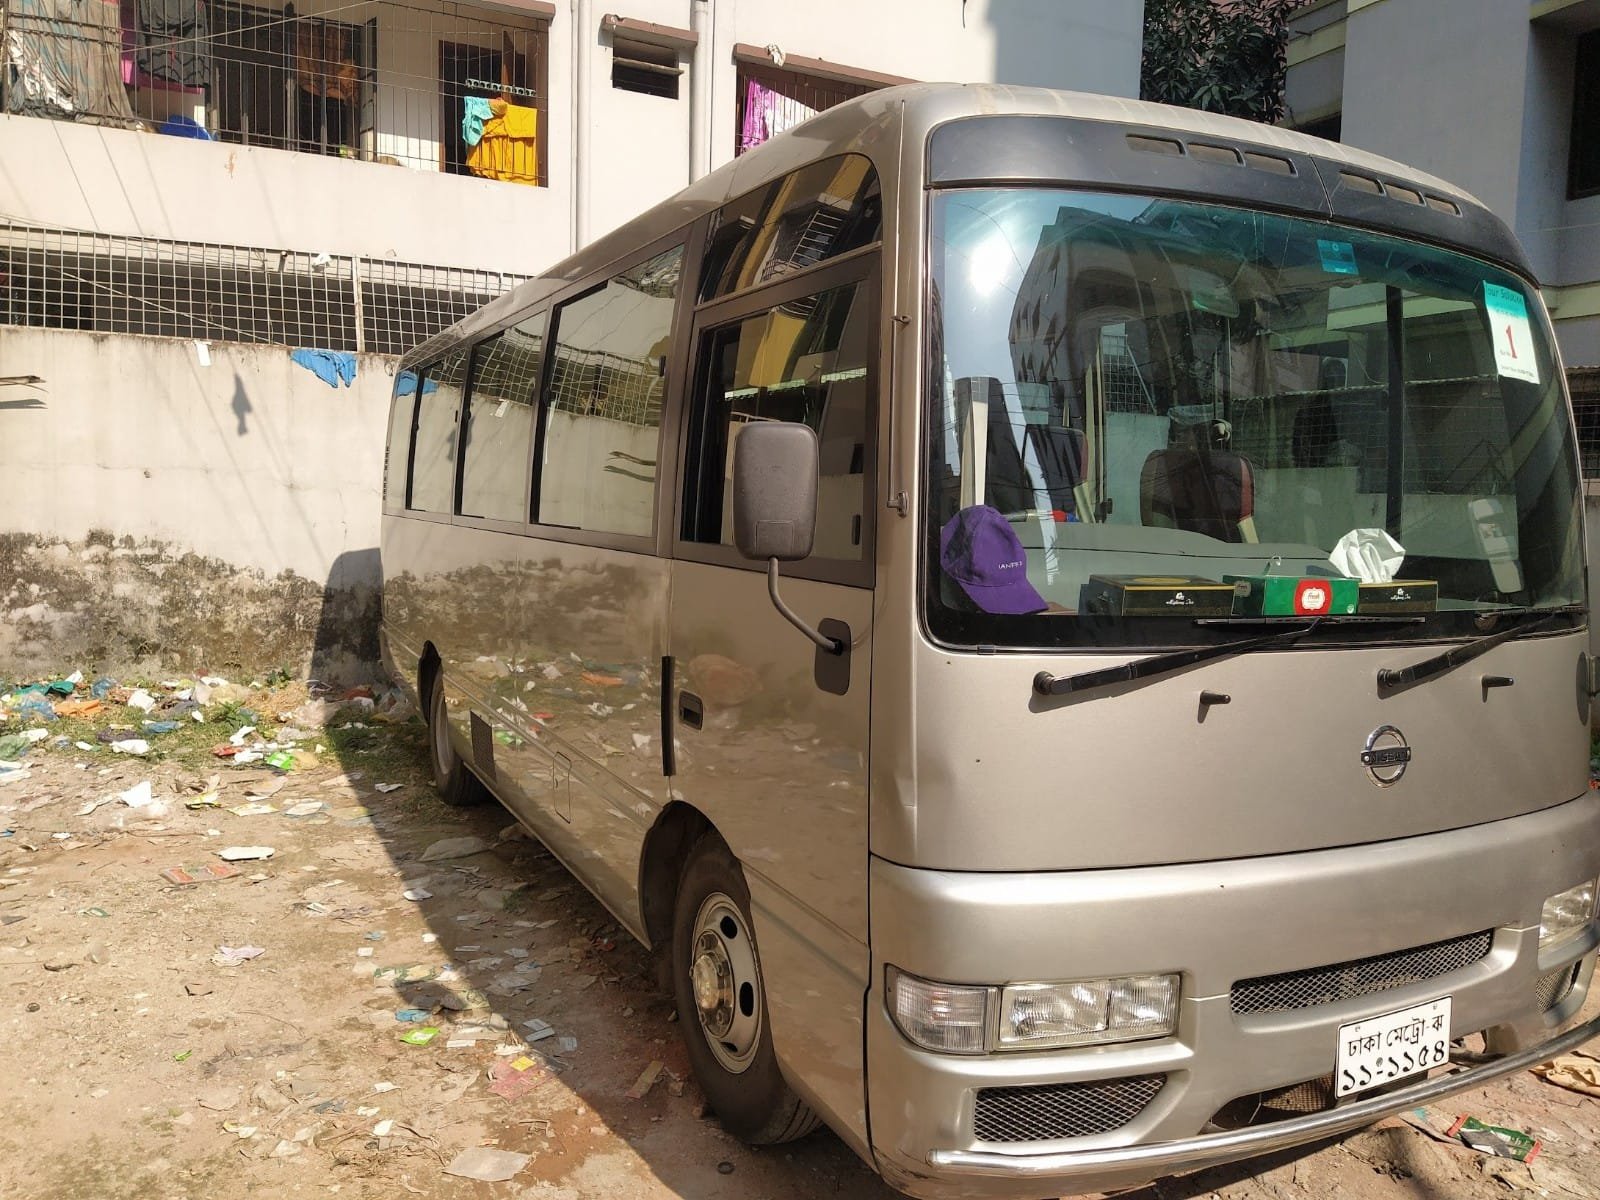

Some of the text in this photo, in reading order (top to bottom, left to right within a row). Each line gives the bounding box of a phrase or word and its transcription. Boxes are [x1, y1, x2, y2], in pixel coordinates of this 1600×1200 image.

[1506, 325, 1518, 359] 1
[1347, 1032, 1382, 1056] ঢাকা
[1342, 1040, 1446, 1091] ১১-১১৫৪
